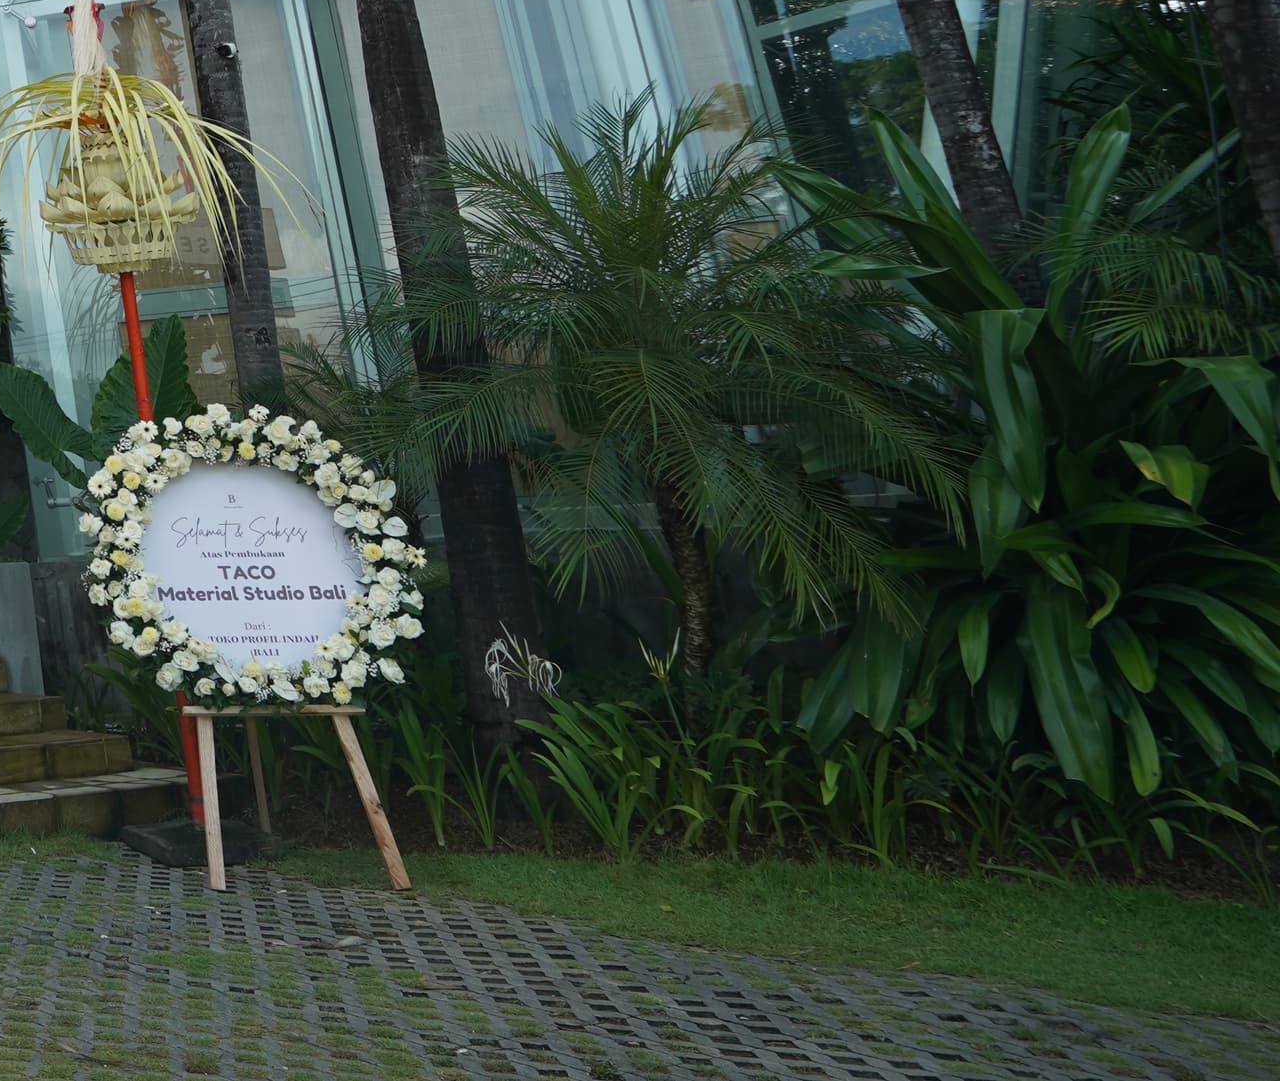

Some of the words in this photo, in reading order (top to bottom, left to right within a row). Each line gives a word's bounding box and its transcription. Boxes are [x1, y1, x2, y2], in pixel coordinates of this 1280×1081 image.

[170, 516, 241, 549] Selamat
[248, 516, 308, 547] Sukses
[200, 551, 223, 559] Atas
[225, 550, 286, 559] Pembukaan
[217, 565, 277, 581] TACO
[157, 586, 239, 602] Material
[244, 585, 305, 601] Studio
[309, 584, 347, 601] Bali
[244, 622, 267, 631] Dari
[208, 635, 239, 644] TOKO
[241, 635, 281, 644] PROFIL
[253, 648, 280, 657] BALI
